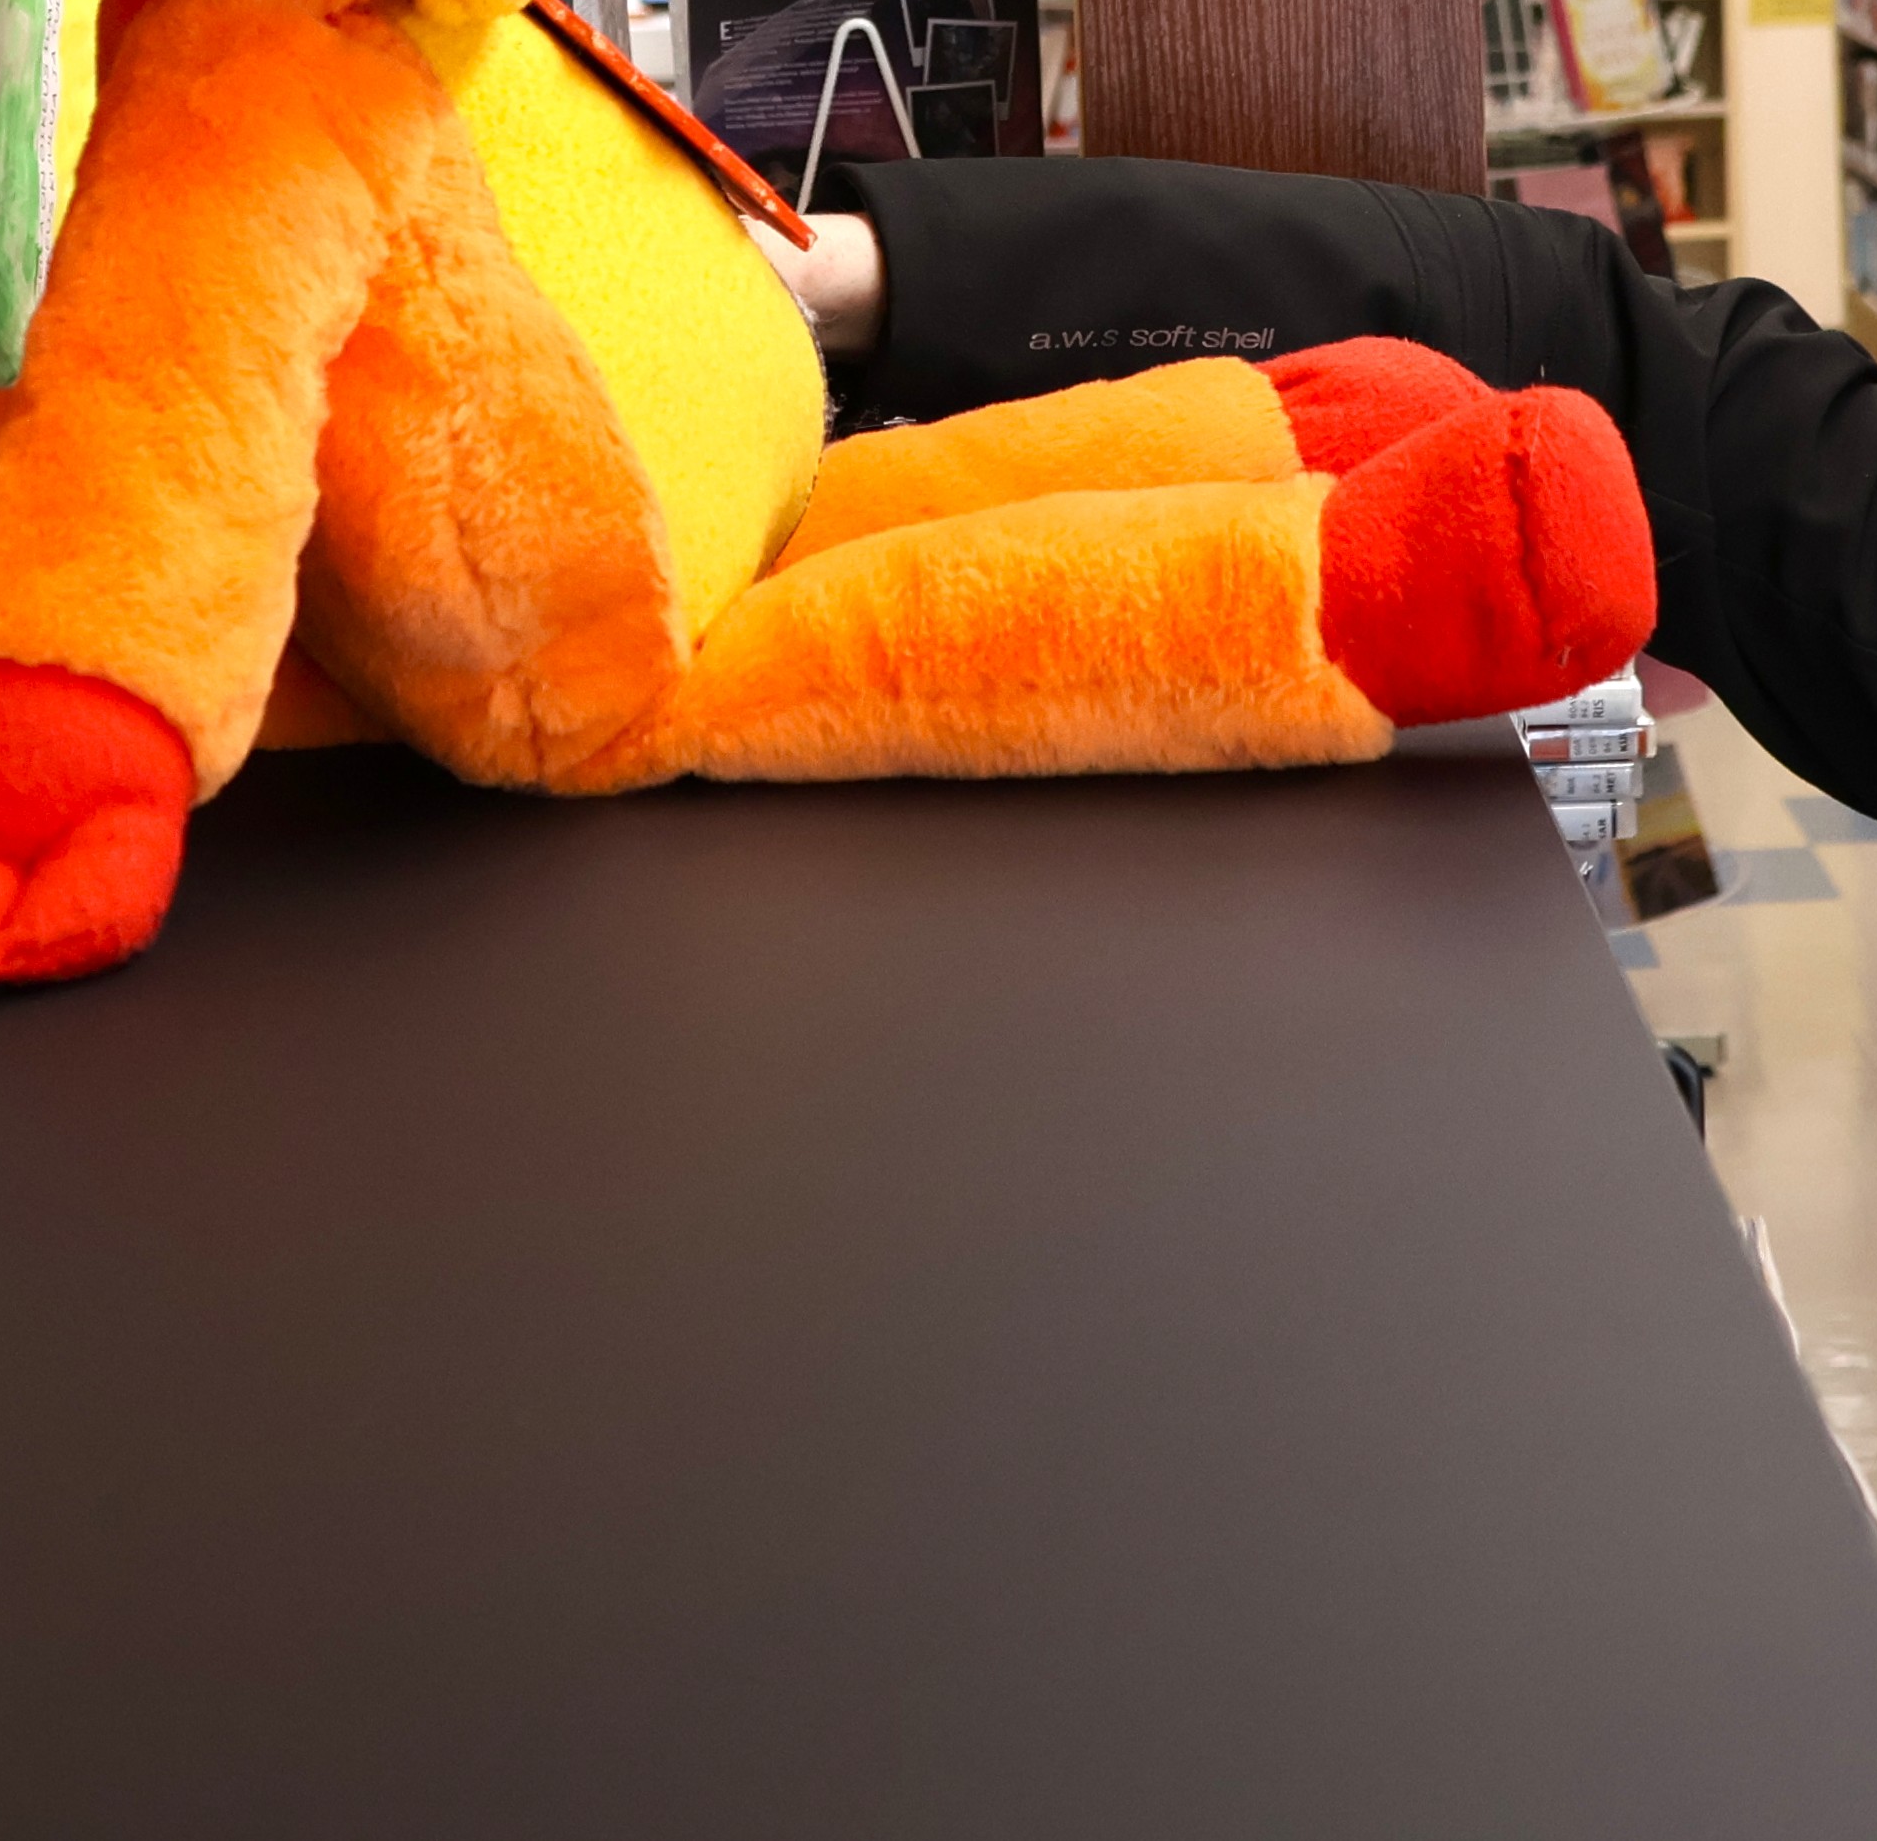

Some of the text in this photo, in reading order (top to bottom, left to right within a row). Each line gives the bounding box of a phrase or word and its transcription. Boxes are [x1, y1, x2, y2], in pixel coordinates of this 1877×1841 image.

[1029, 324, 1275, 351] a.w.s soft shell
[1592, 698, 1604, 719] RIS
